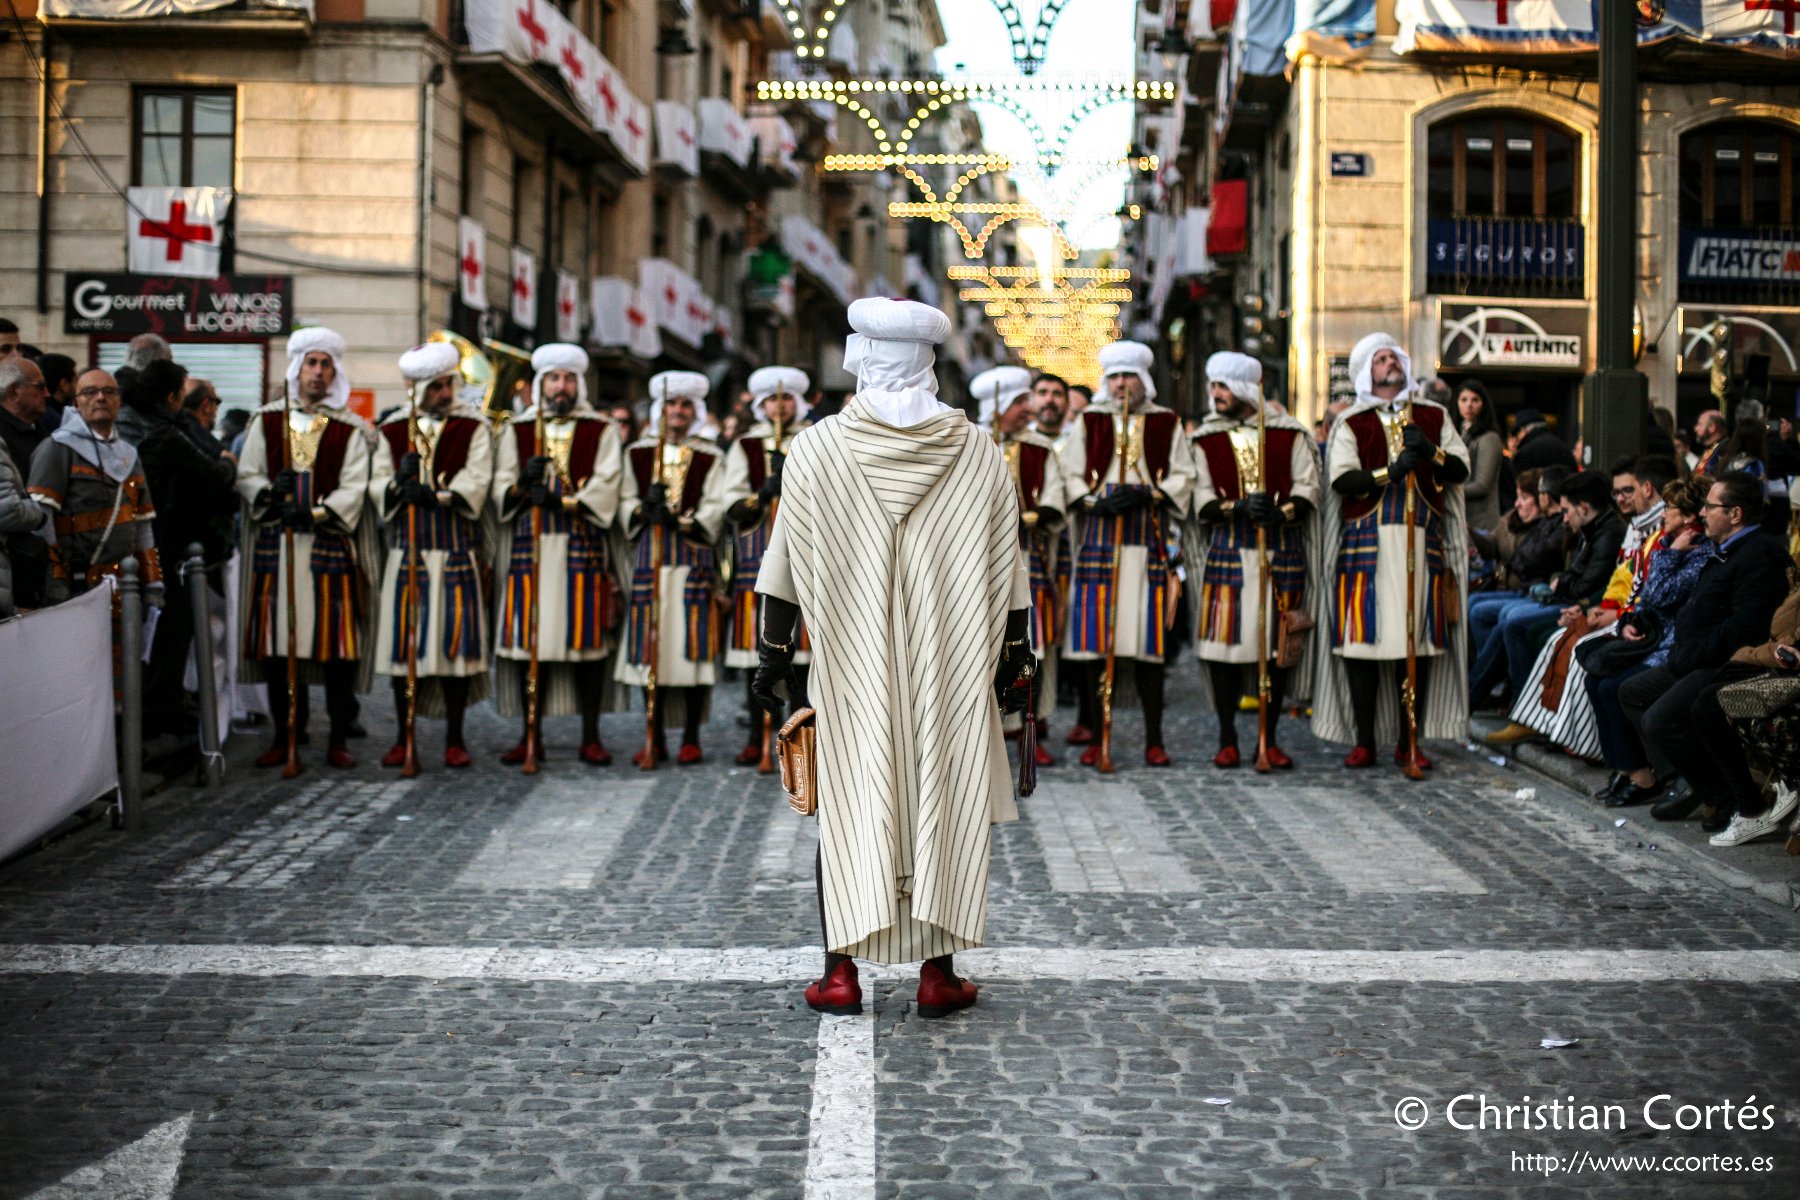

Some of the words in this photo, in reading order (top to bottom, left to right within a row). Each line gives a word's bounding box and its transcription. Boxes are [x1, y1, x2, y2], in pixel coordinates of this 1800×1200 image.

[1435, 242, 1576, 265] SEGUROS
[73, 280, 186, 319] Gourmet
[210, 292, 283, 312] VINOS
[184, 312, 283, 332] LICORES
